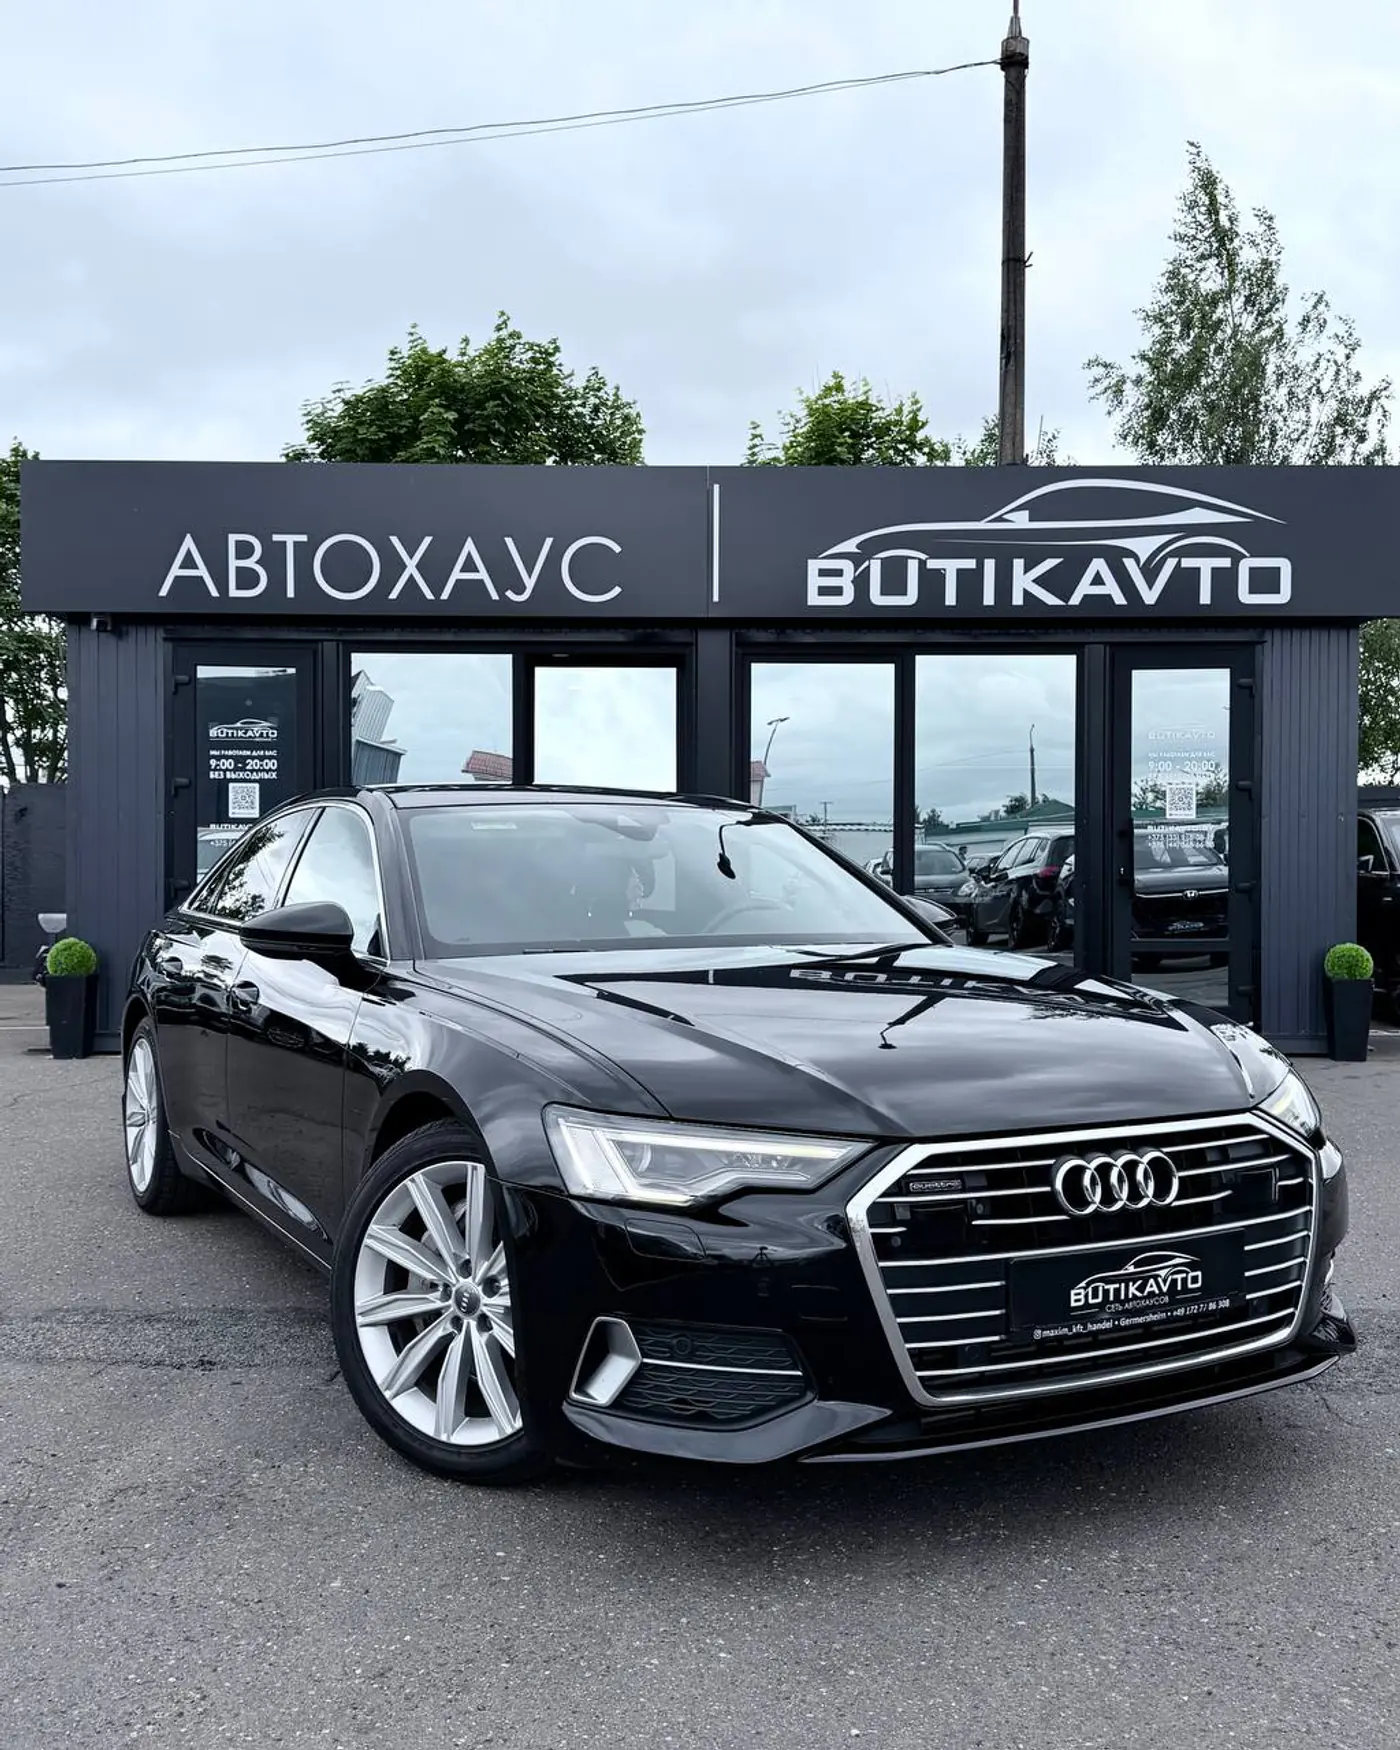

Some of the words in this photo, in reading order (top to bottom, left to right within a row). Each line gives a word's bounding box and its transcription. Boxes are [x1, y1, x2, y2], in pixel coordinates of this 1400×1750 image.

[158, 533, 623, 603] АВТОХАУС
[807, 557, 1292, 606] BUTIKAVTO
[209, 729, 278, 738] BUTIKAVTO
[209, 759, 235, 770] 9:00
[245, 759, 278, 770] 20:00
[1148, 761, 1172, 771] 9:00
[1183, 760, 1216, 771] 20:00
[209, 771, 224, 779] БЕЗ
[225, 771, 278, 780] ВЫХОДНЫХ
[913, 1181, 962, 1191] quattro
[1070, 1271, 1203, 1307] BUTIKAVTO
[1105, 1302, 1124, 1313] СЕТЬ
[1124, 1295, 1170, 1310] АВТОХАУСОВ
[1119, 1311, 1167, 1327] Germersheim
[1173, 1307, 1186, 1317] +49
[1186, 1304, 1198, 1315] 172
